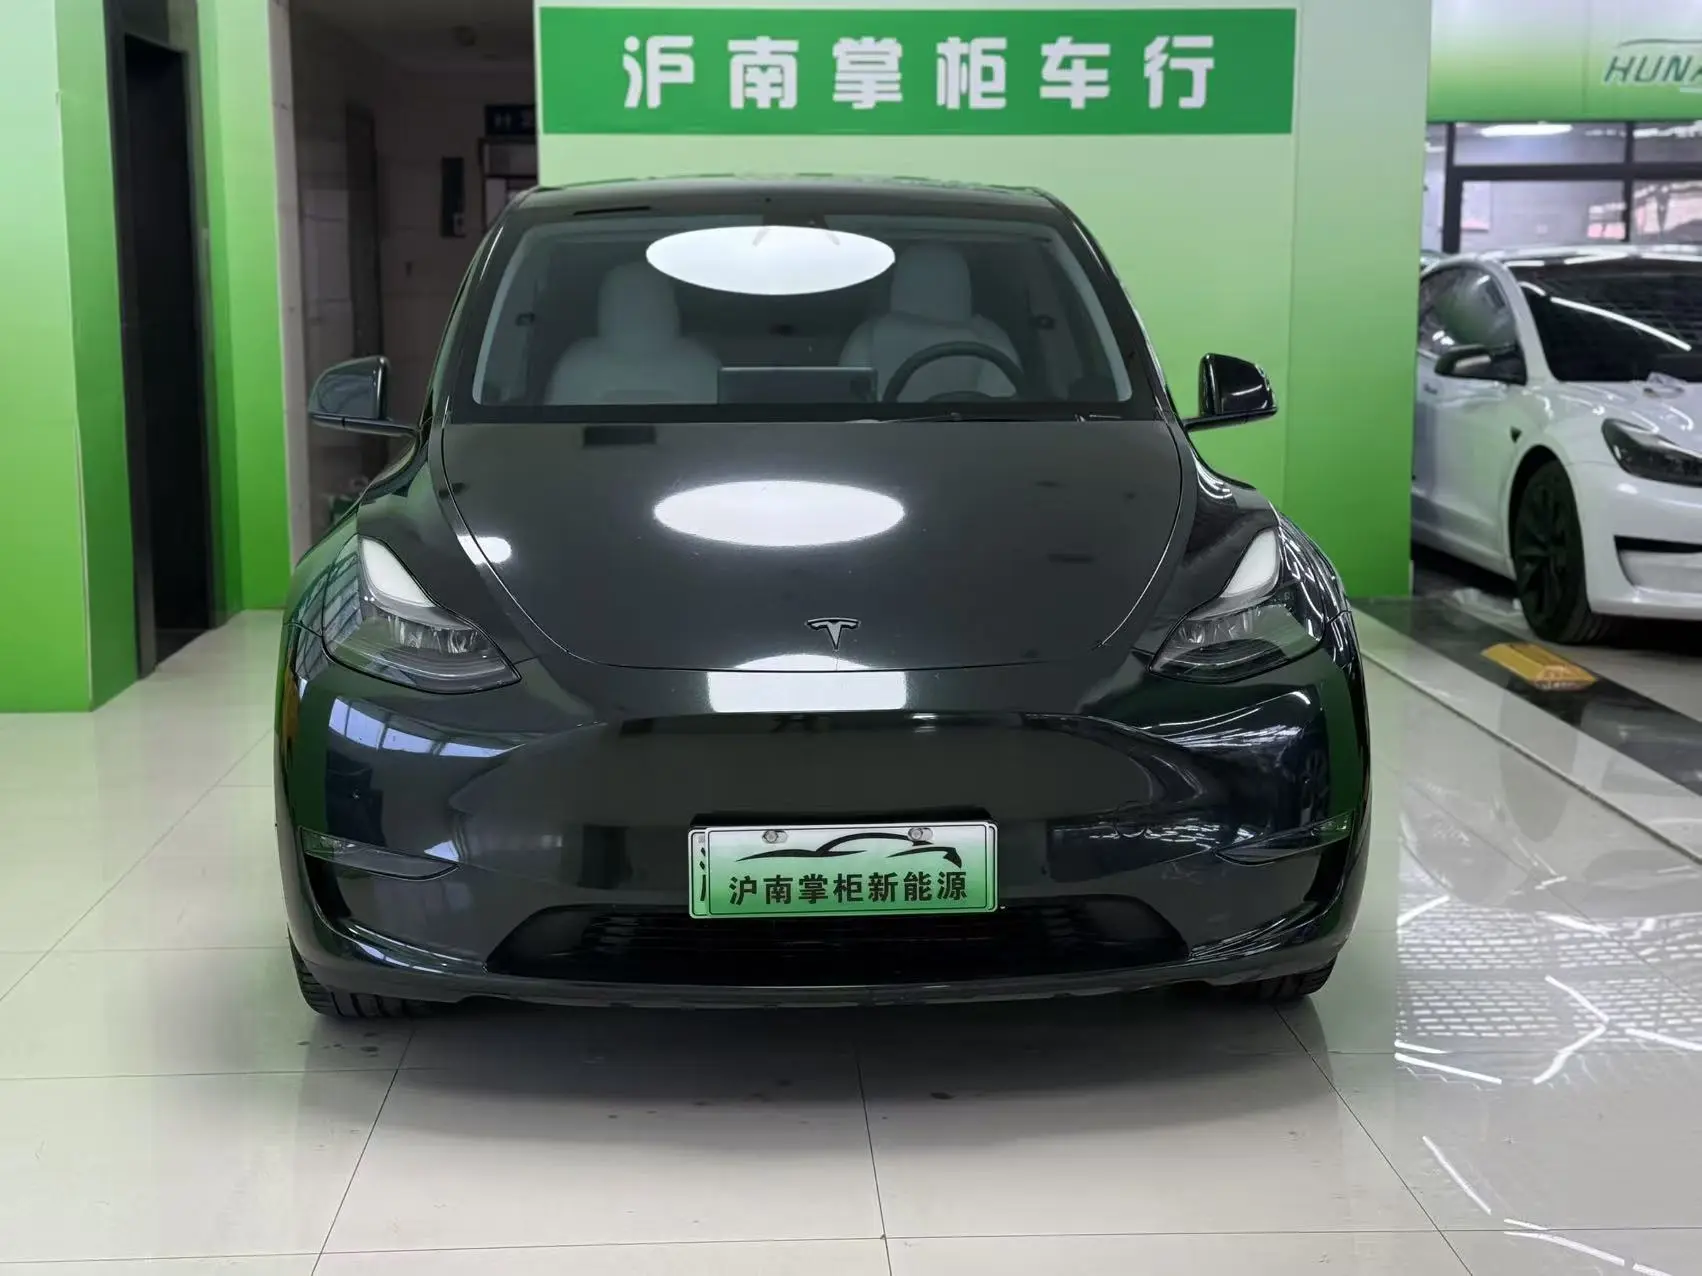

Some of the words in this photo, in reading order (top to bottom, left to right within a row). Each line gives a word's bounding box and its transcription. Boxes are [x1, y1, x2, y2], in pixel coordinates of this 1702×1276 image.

[623, 35, 1214, 109] 沪南掌柜车行
[729, 871, 968, 906] 沪南掌柜新能源
